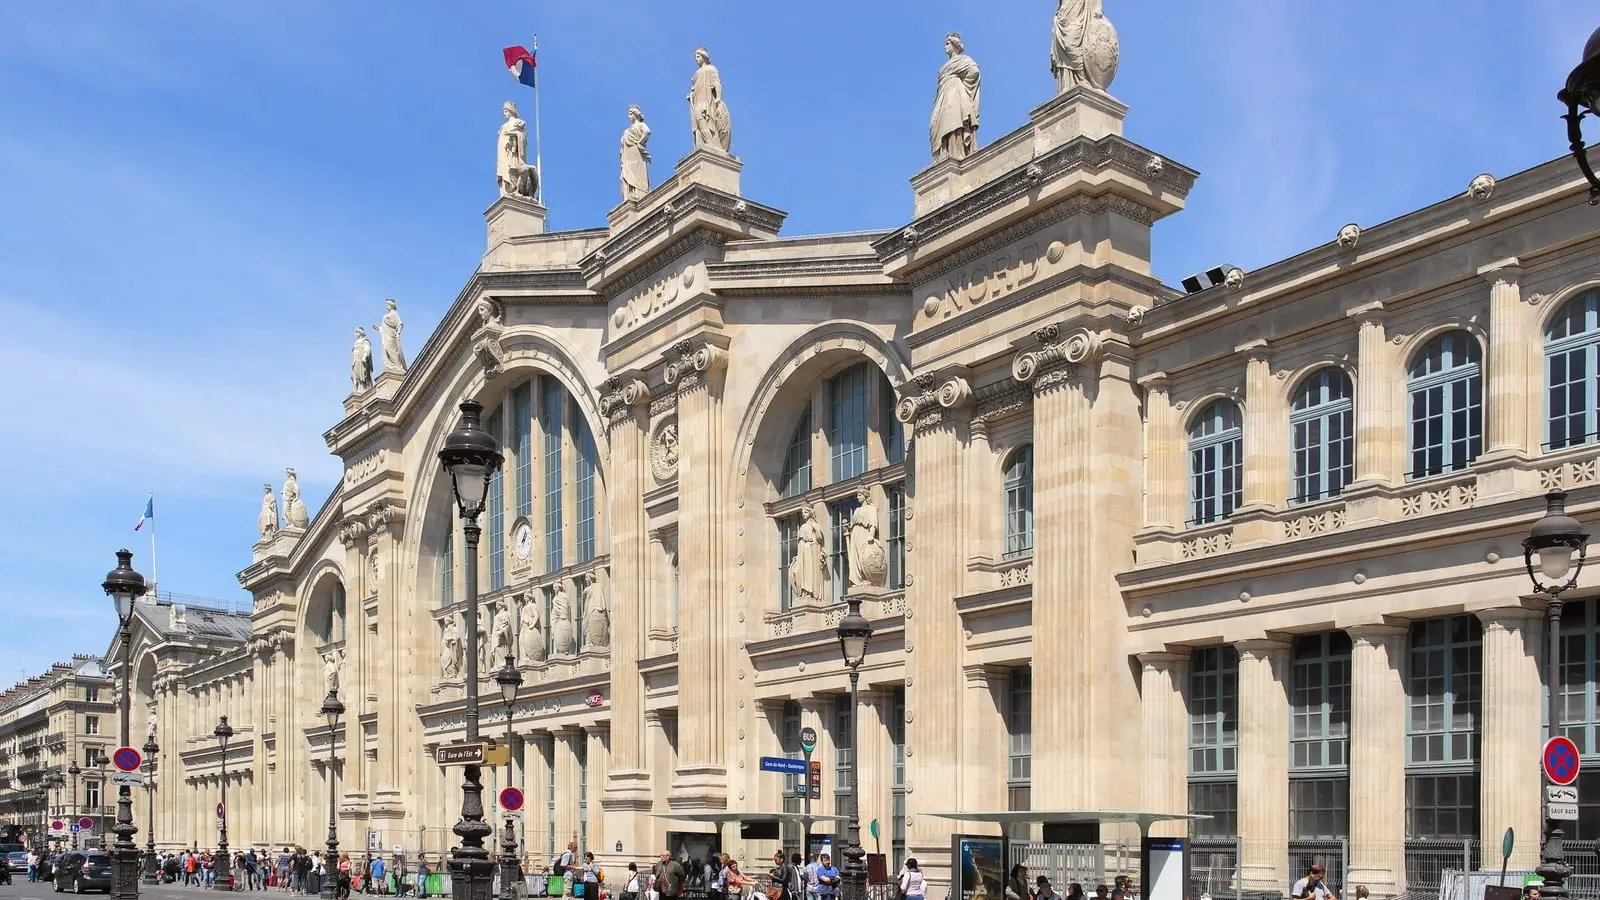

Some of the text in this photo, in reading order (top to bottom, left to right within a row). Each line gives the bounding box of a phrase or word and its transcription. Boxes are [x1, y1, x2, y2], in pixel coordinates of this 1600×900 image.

[943, 242, 1040, 319] NORD
[627, 270, 679, 328] NORD
[803, 733, 815, 741] BUS
[464, 750, 473, 758] l'Est
